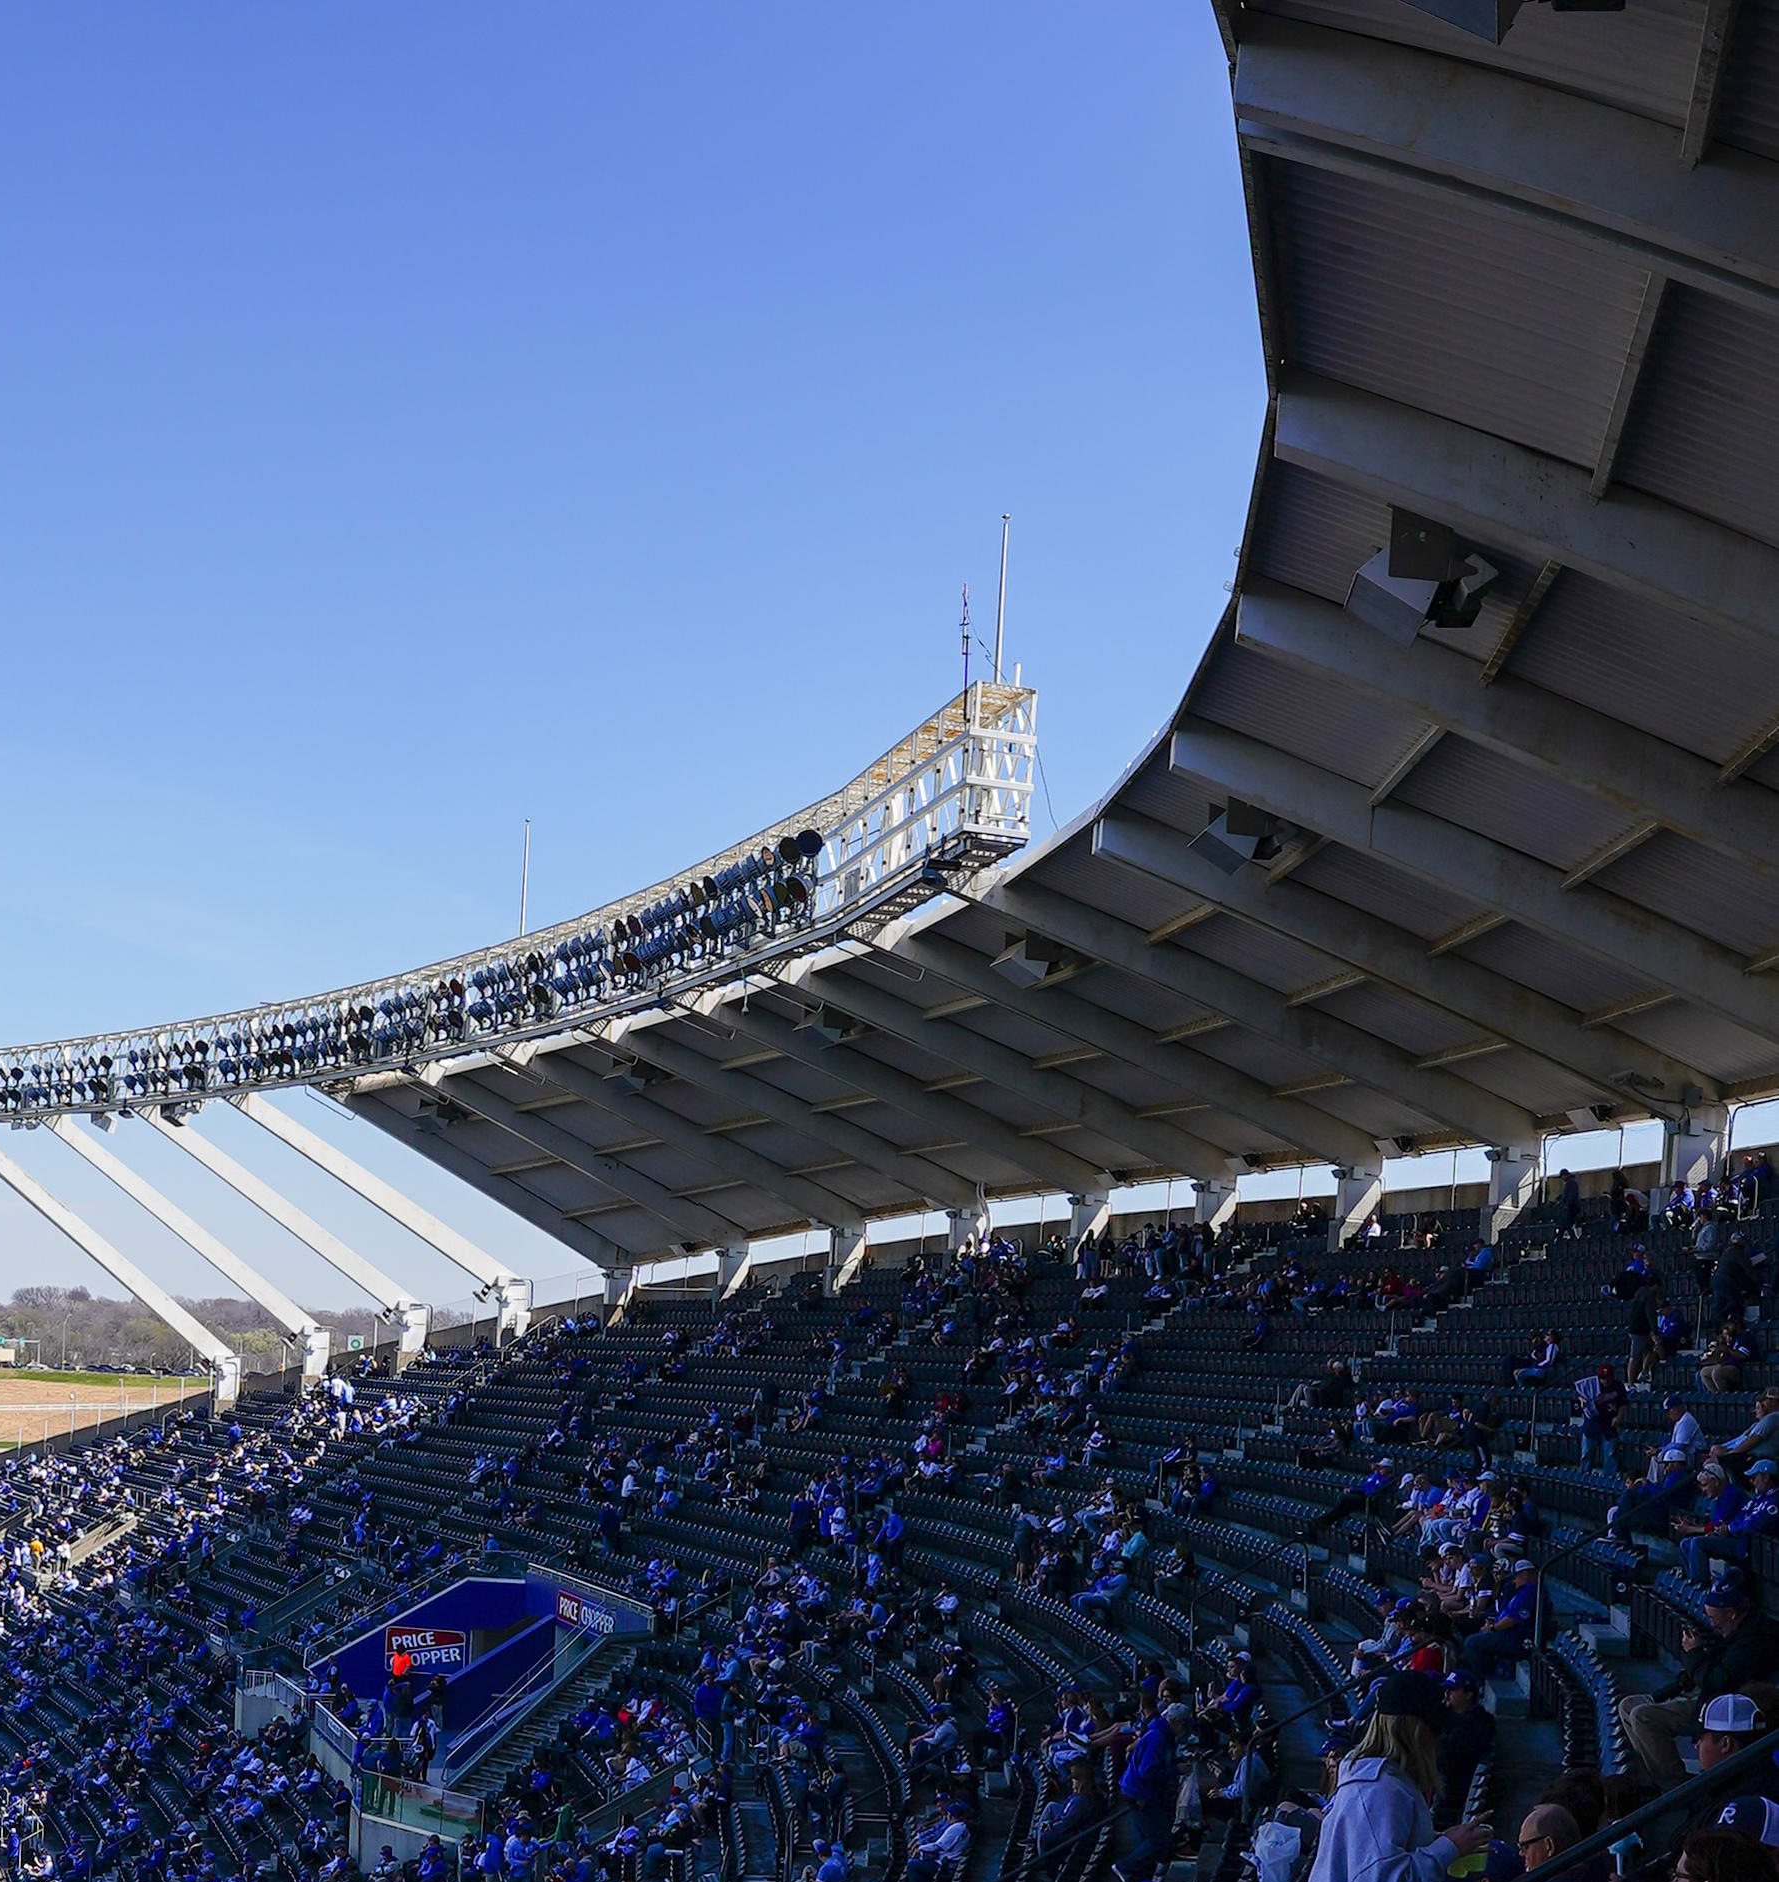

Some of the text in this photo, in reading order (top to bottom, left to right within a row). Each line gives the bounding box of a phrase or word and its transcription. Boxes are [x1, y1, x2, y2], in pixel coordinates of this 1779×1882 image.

[559, 1596, 578, 1621] PRICE
[391, 1631, 436, 1650] PRICE
[390, 1647, 462, 1668] OPPER
